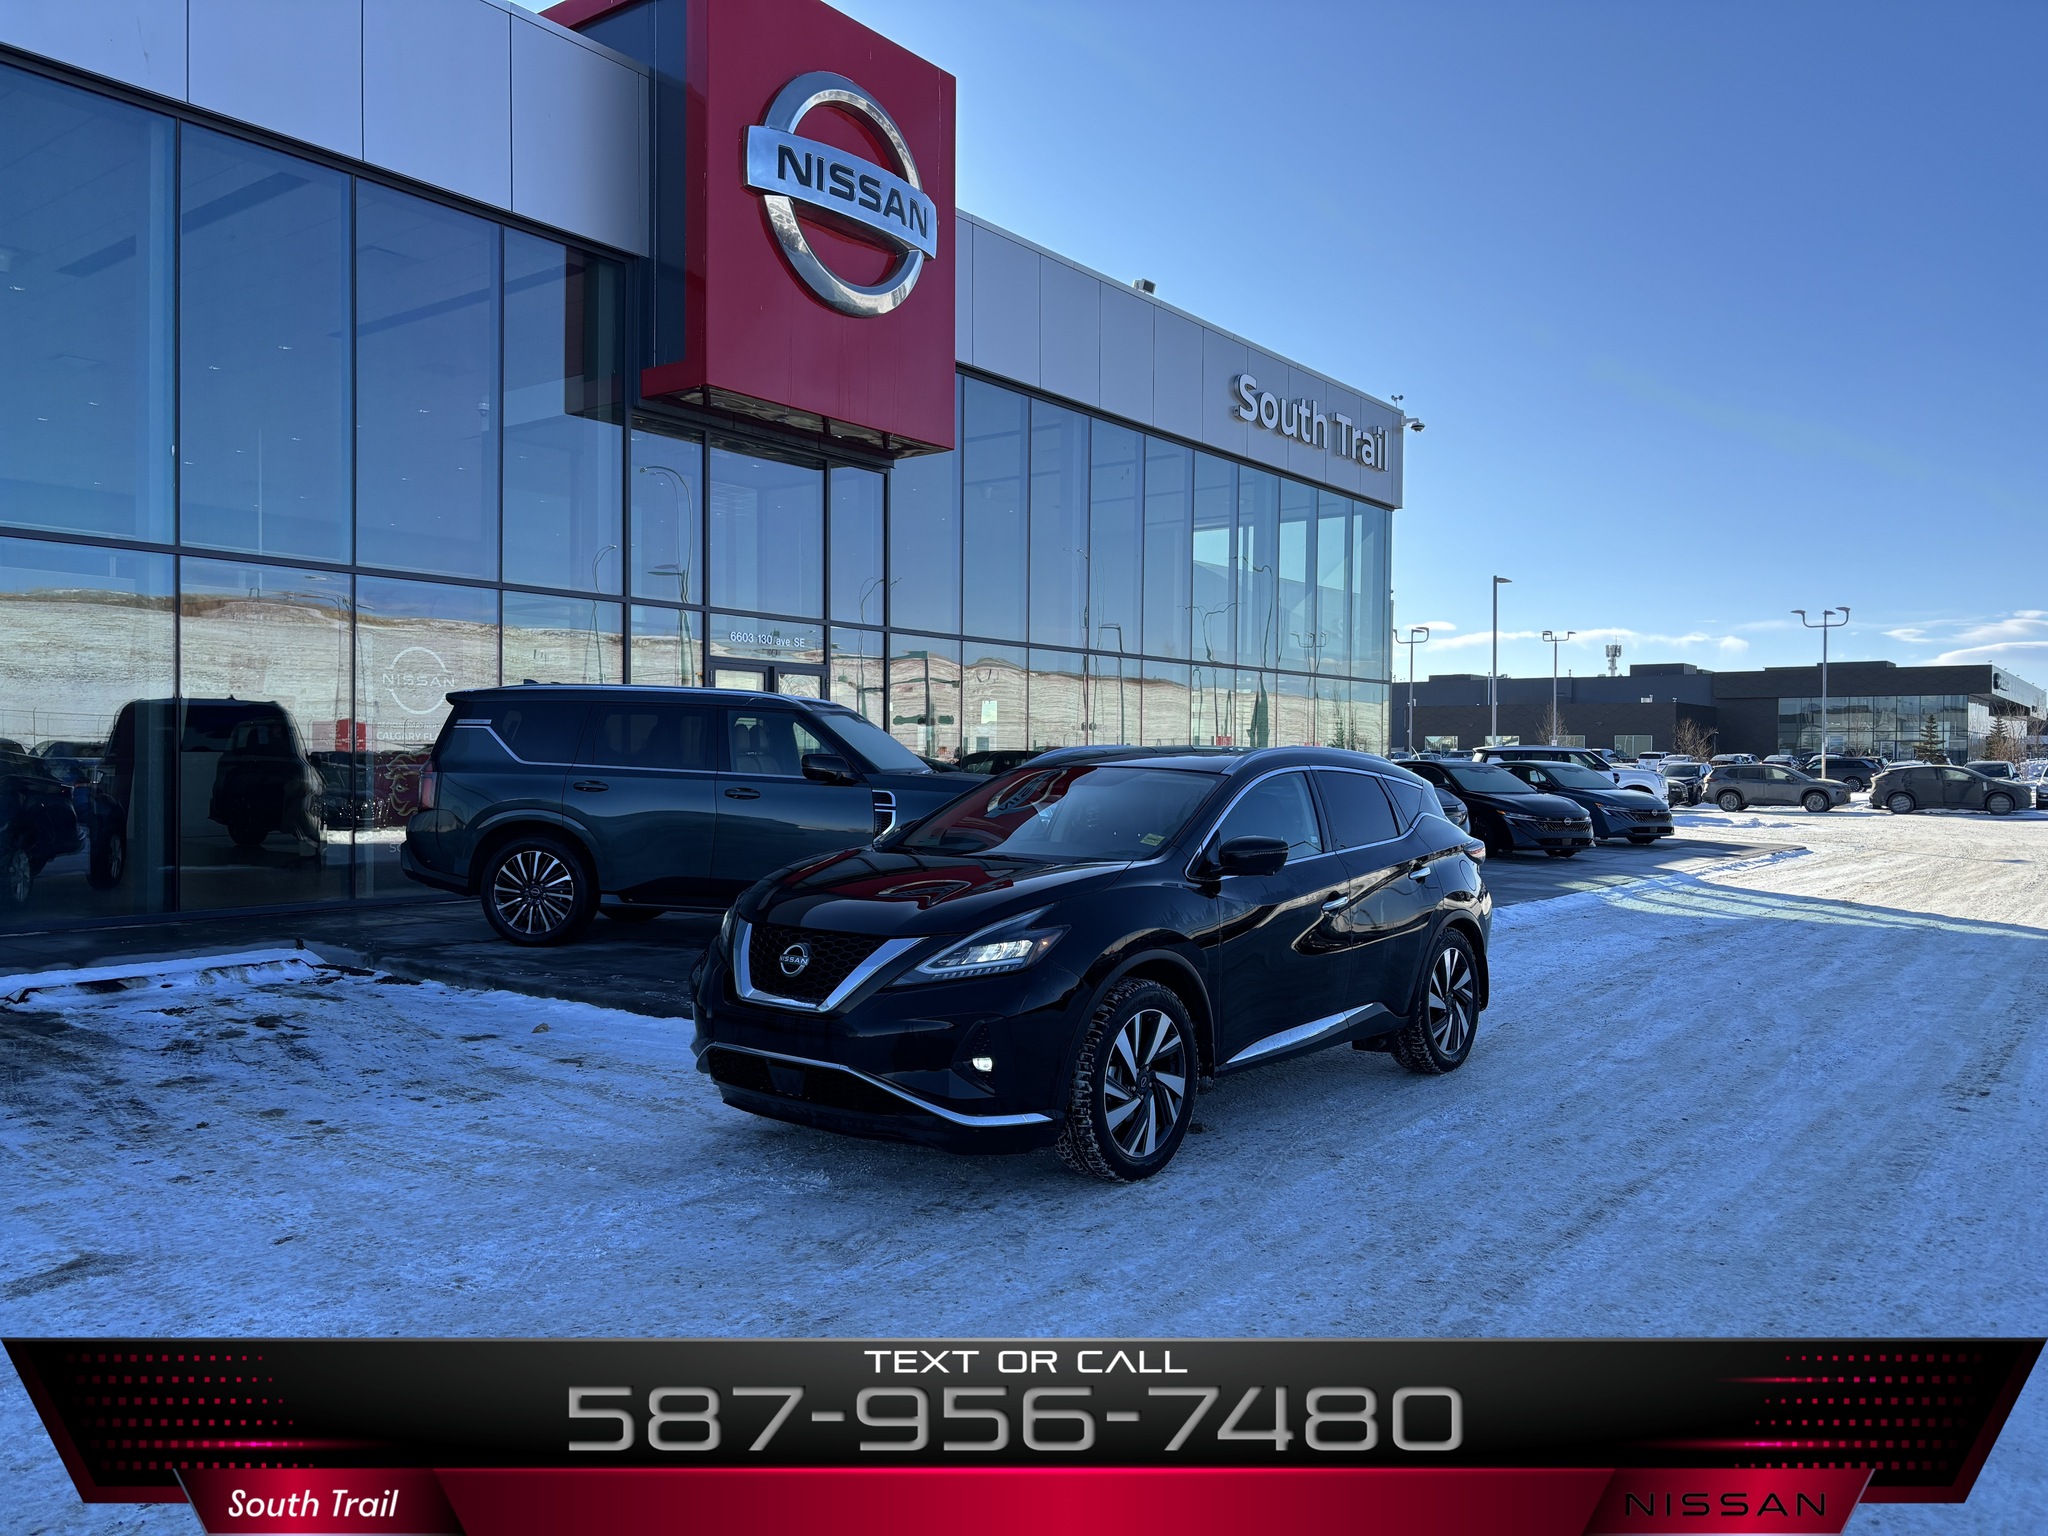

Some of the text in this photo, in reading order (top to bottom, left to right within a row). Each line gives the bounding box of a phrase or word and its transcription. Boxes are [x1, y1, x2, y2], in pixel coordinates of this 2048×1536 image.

[777, 144, 928, 239] NISSAN
[1235, 374, 1389, 472] South Trail
[730, 631, 805, 648] 6603 130 ave SE
[382, 673, 455, 688] NISSAN
[376, 731, 421, 741] CALGARY
